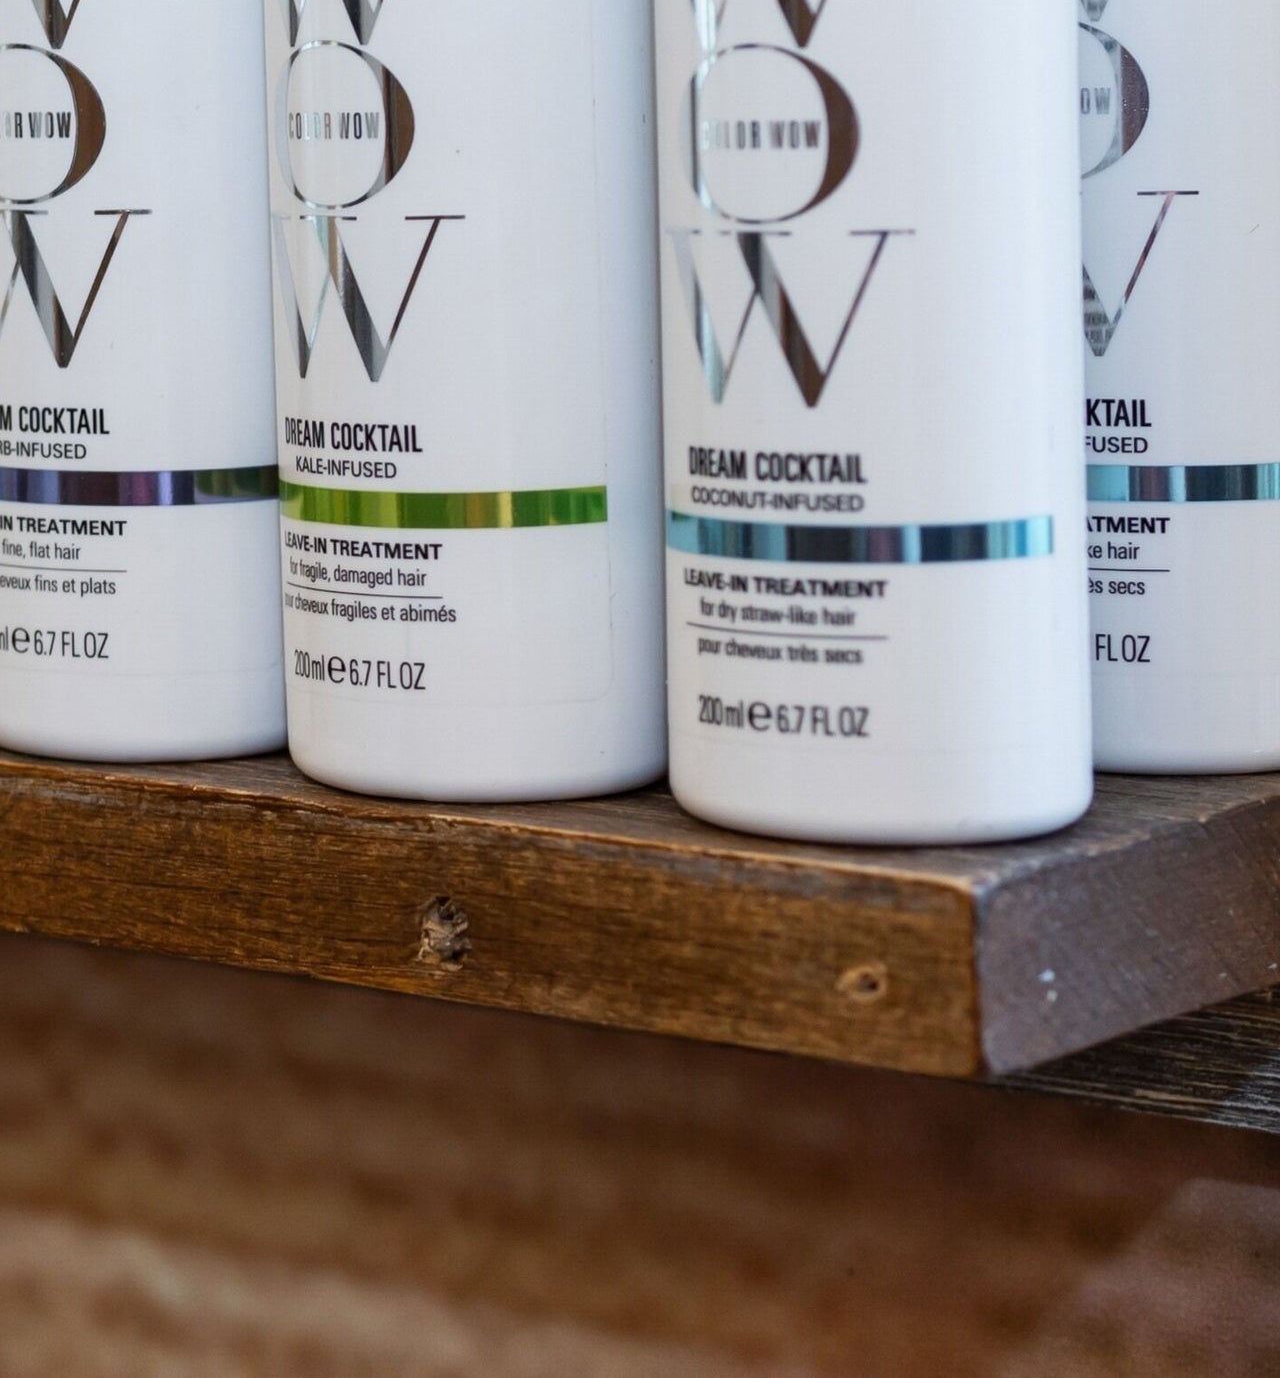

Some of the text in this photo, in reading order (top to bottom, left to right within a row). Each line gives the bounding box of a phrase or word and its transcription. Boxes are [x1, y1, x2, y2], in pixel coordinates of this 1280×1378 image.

[1080, 87, 1111, 115] OW
[28, 111, 72, 139] WOW
[338, 112, 381, 140] WOW
[768, 120, 822, 150] WOW
[18, 406, 110, 435] COCKTAIL
[1085, 398, 1152, 428] KTAIL
[285, 416, 423, 453] DREAM COCKTAIL
[295, 455, 397, 479] KALE-INFUSED
[689, 445, 868, 484] DREAM COCKTAIL
[691, 485, 866, 513] COCONUT-INFUSED
[16, 516, 128, 536] TREATMENT
[2, 538, 27, 559] fine,
[29, 541, 51, 559] flat
[54, 543, 81, 560] hair
[284, 530, 443, 560] LEAVE-IN TREATMENT
[1107, 541, 1141, 560] hair
[34, 574, 58, 593] fins
[62, 578, 76, 594] et
[80, 577, 117, 598] plats
[299, 559, 331, 583] fragile,
[334, 564, 393, 589] damaged
[397, 568, 427, 587] hair
[684, 567, 889, 598] LEAVE-IN TREATMENT
[1108, 578, 1146, 596] secs
[295, 592, 329, 615] cheveux
[331, 598, 378, 622] fragiles
[381, 604, 395, 621] et
[400, 604, 457, 623] abimés
[700, 596, 856, 626] for dry straw-like hair
[34, 629, 56, 657] 6.7
[60, 631, 81, 658] FL
[83, 632, 110, 659] OZ
[698, 637, 864, 664] pour cheveux très secs
[1095, 633, 1151, 663] FL OZ
[349, 658, 372, 687] 6.7
[376, 660, 397, 689] FL
[399, 661, 427, 691] OZ
[776, 703, 806, 735] 6.7
[810, 705, 835, 738] FL
[838, 706, 871, 739] OZ
